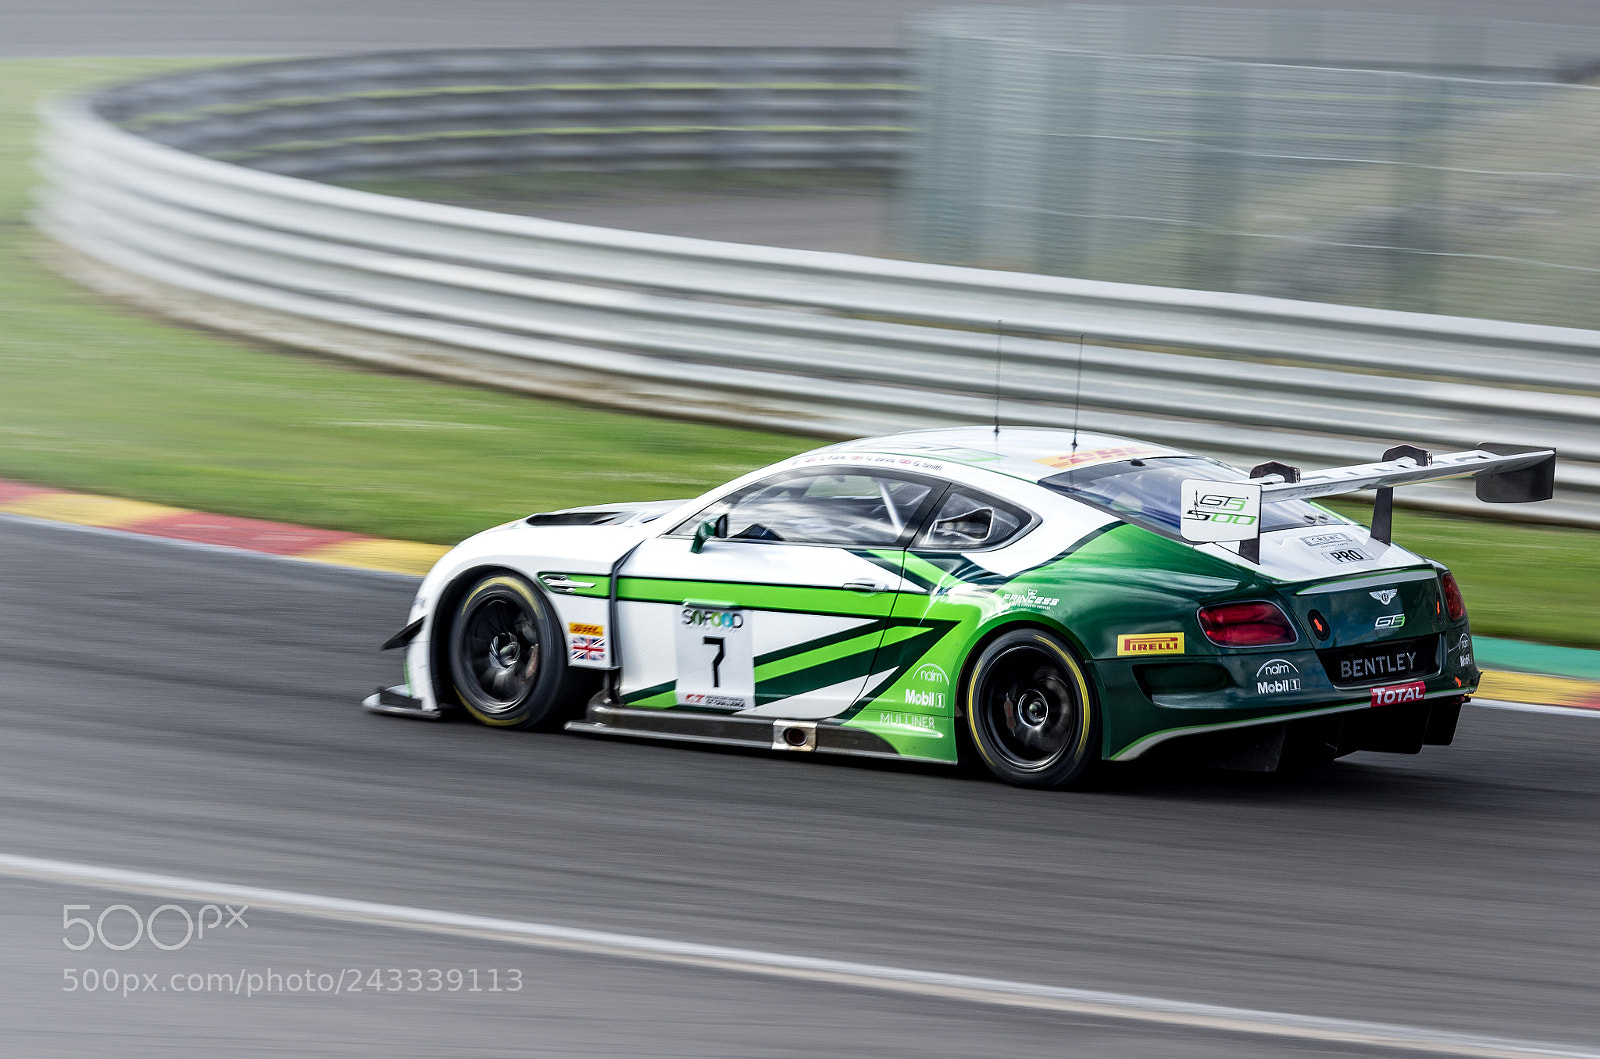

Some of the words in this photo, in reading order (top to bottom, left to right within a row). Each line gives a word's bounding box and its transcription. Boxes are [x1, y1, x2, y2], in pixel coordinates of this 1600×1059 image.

[1200, 494, 1246, 511] GT3
[1330, 549, 1364, 563] PRO
[1002, 593, 1060, 606] PRINCESS
[1374, 613, 1406, 628] GT3
[572, 624, 604, 635] DHL
[1124, 636, 1179, 651] PIRELLI
[702, 636, 725, 688] 7
[1340, 651, 1417, 679] BENTLEY
[1372, 686, 1424, 705] TOTAL
[879, 712, 935, 729] MULLINER
